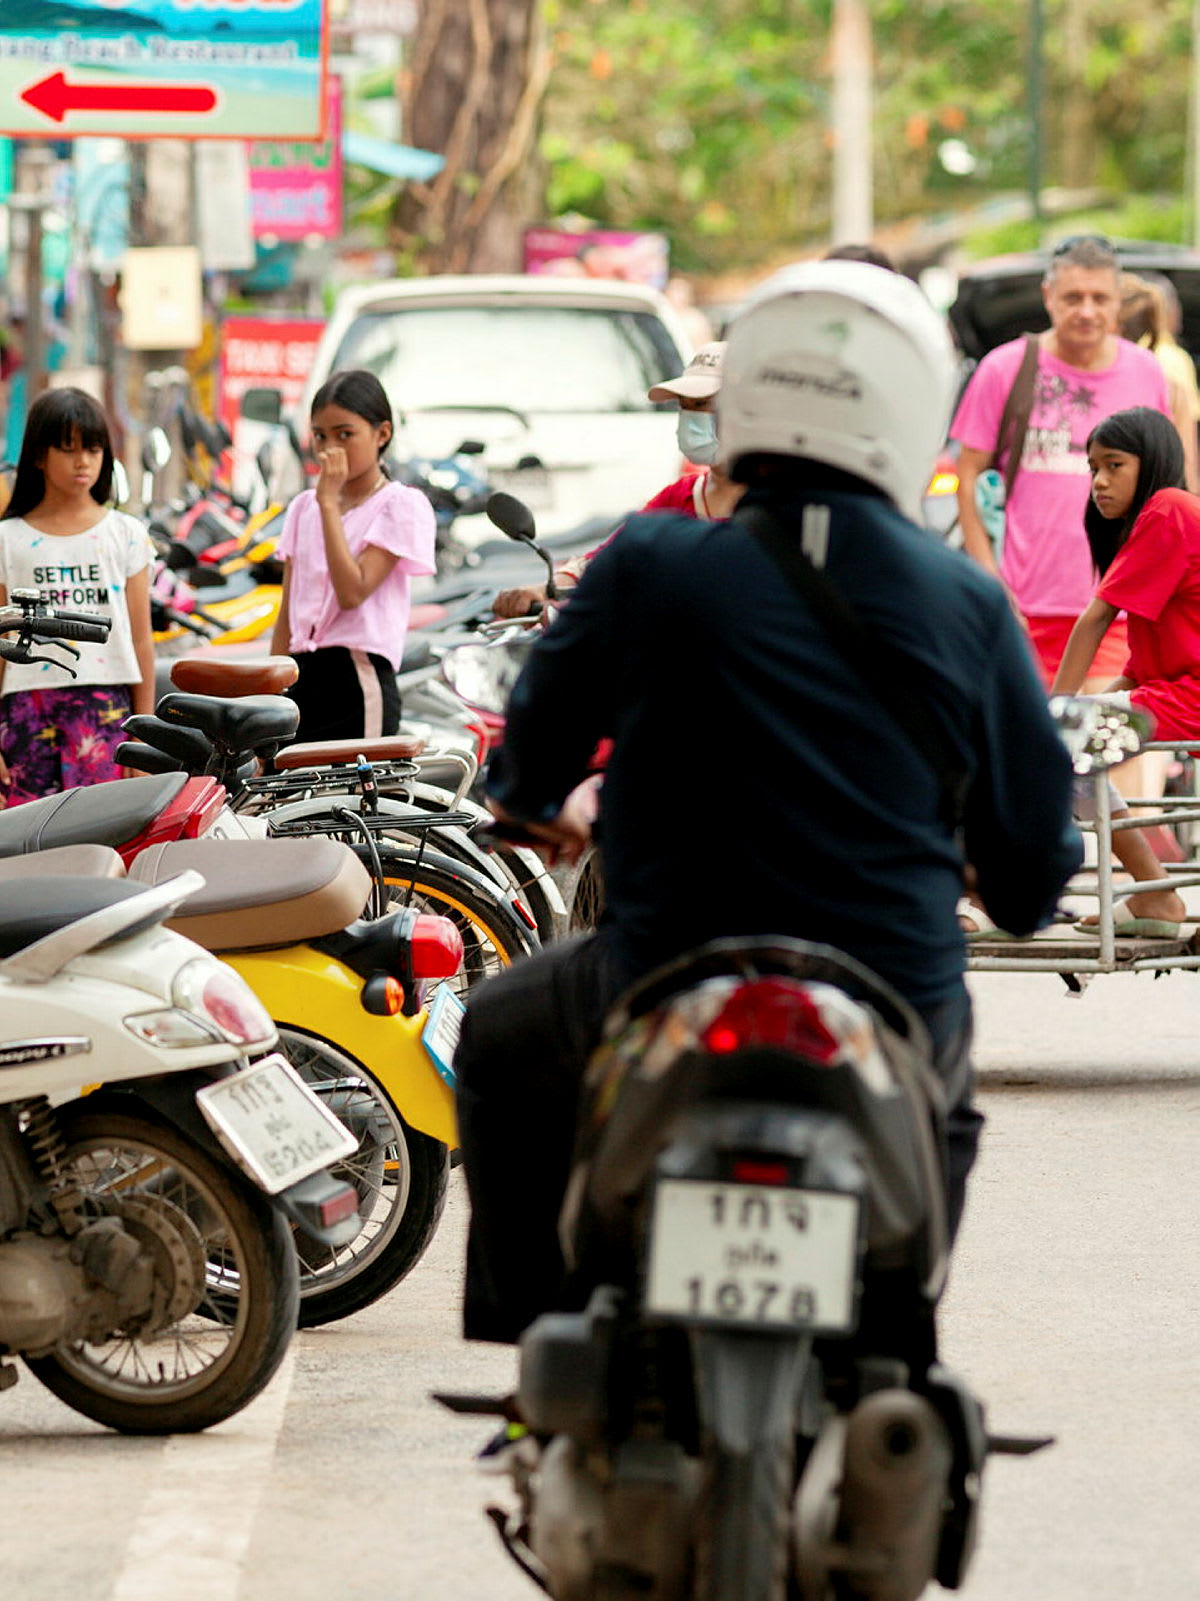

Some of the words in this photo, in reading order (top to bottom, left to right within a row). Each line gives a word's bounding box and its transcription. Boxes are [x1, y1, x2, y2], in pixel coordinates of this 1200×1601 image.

[62, 34, 143, 61] Beach
[152, 38, 298, 64] Restaurant
[33, 564, 100, 585] SETTLE
[39, 588, 110, 606] ERFORM
